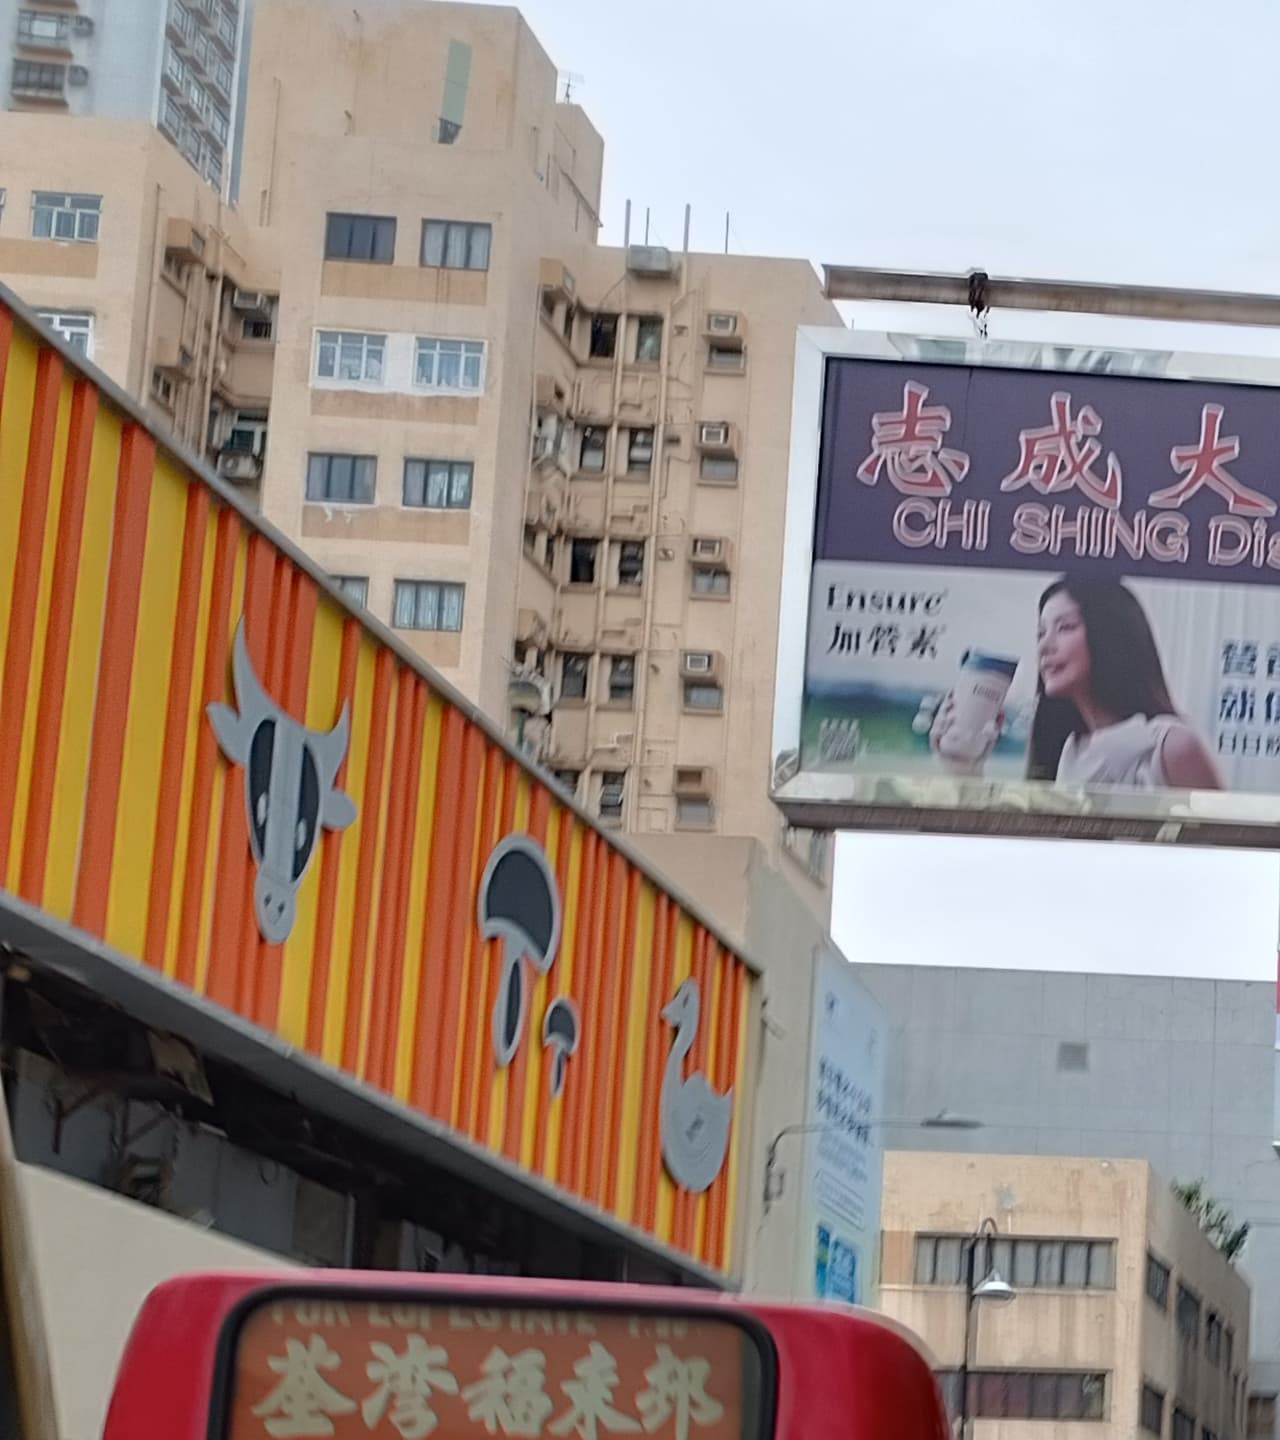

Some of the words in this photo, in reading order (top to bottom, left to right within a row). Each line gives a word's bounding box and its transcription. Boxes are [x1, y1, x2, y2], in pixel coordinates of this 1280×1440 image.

[892, 498, 992, 552] CHI
[1009, 502, 1190, 564] SHING
[827, 583, 946, 614] Ensure
